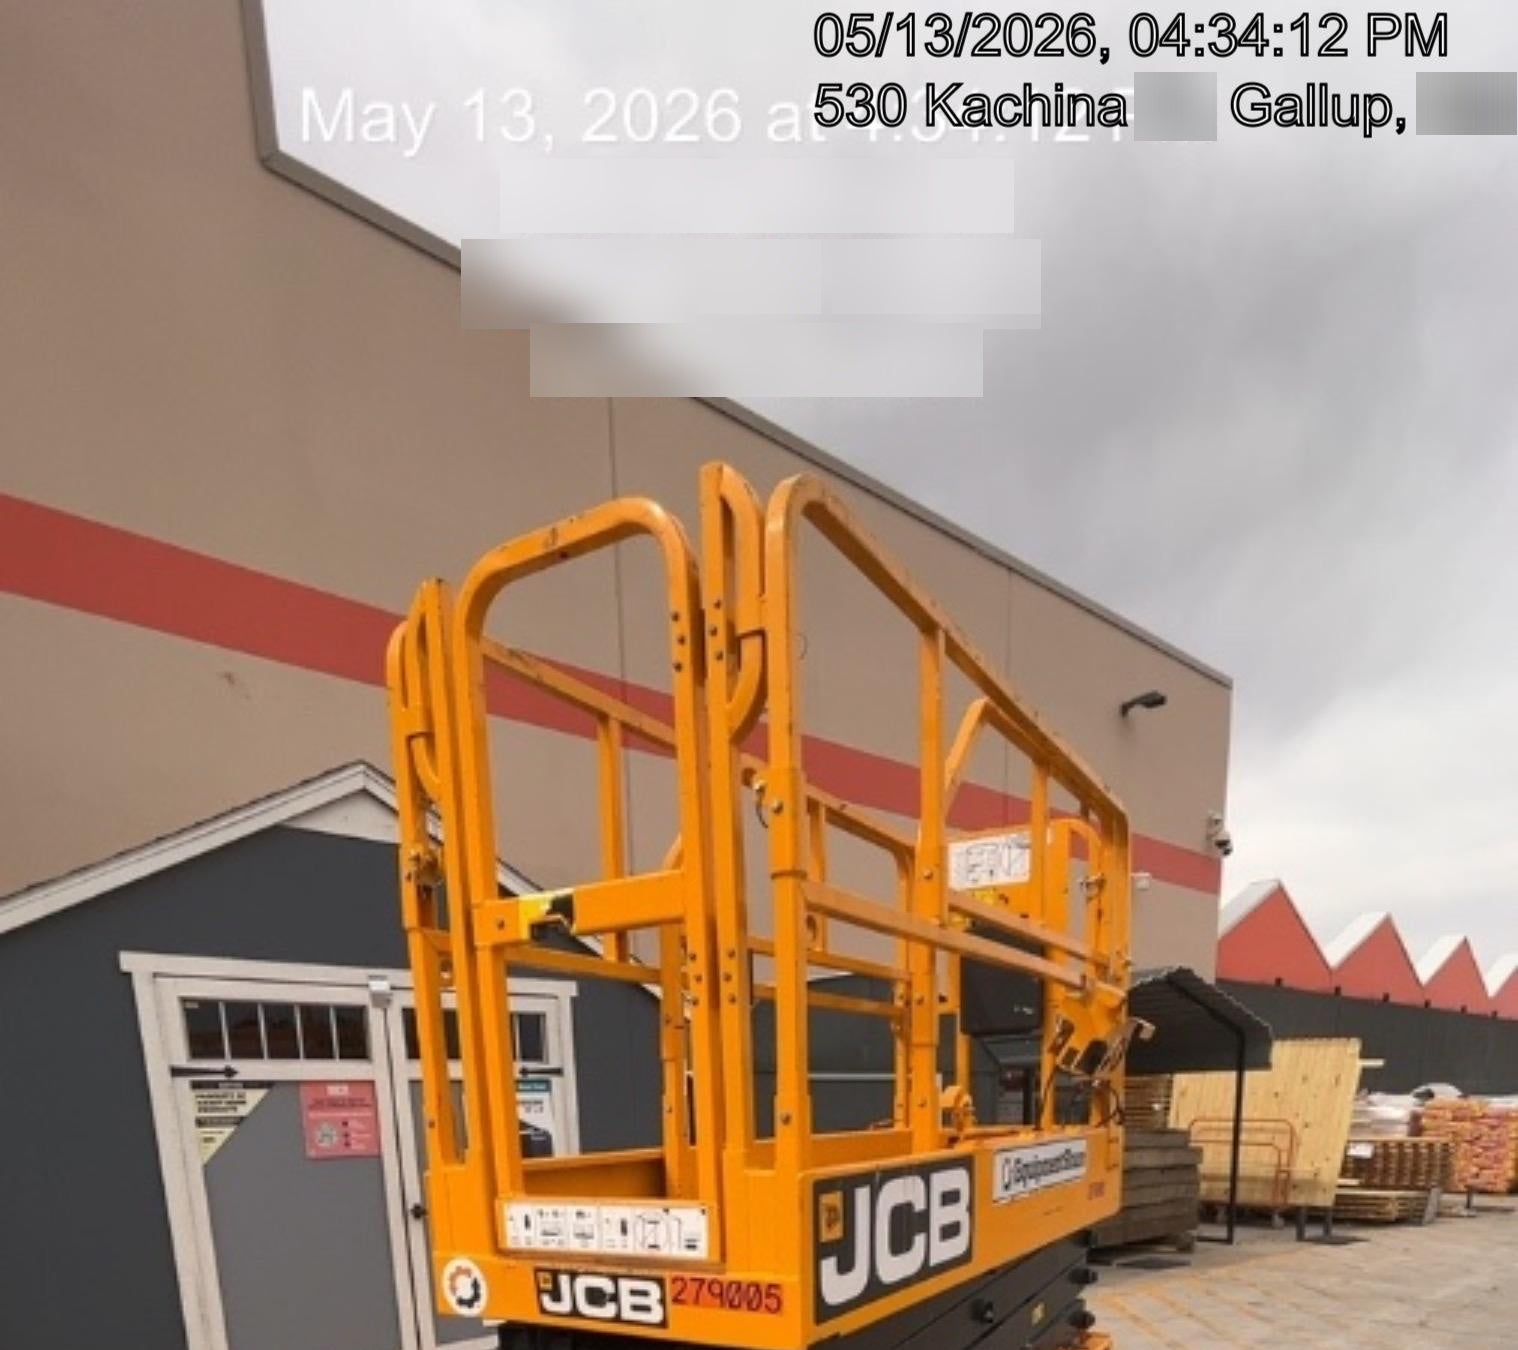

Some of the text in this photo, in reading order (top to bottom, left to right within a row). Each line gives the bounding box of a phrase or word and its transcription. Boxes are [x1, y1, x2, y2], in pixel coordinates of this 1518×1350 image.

[821, 1168, 970, 1306] JCB
[540, 1273, 665, 1324] JCB
[671, 1275, 783, 1314] 279005
